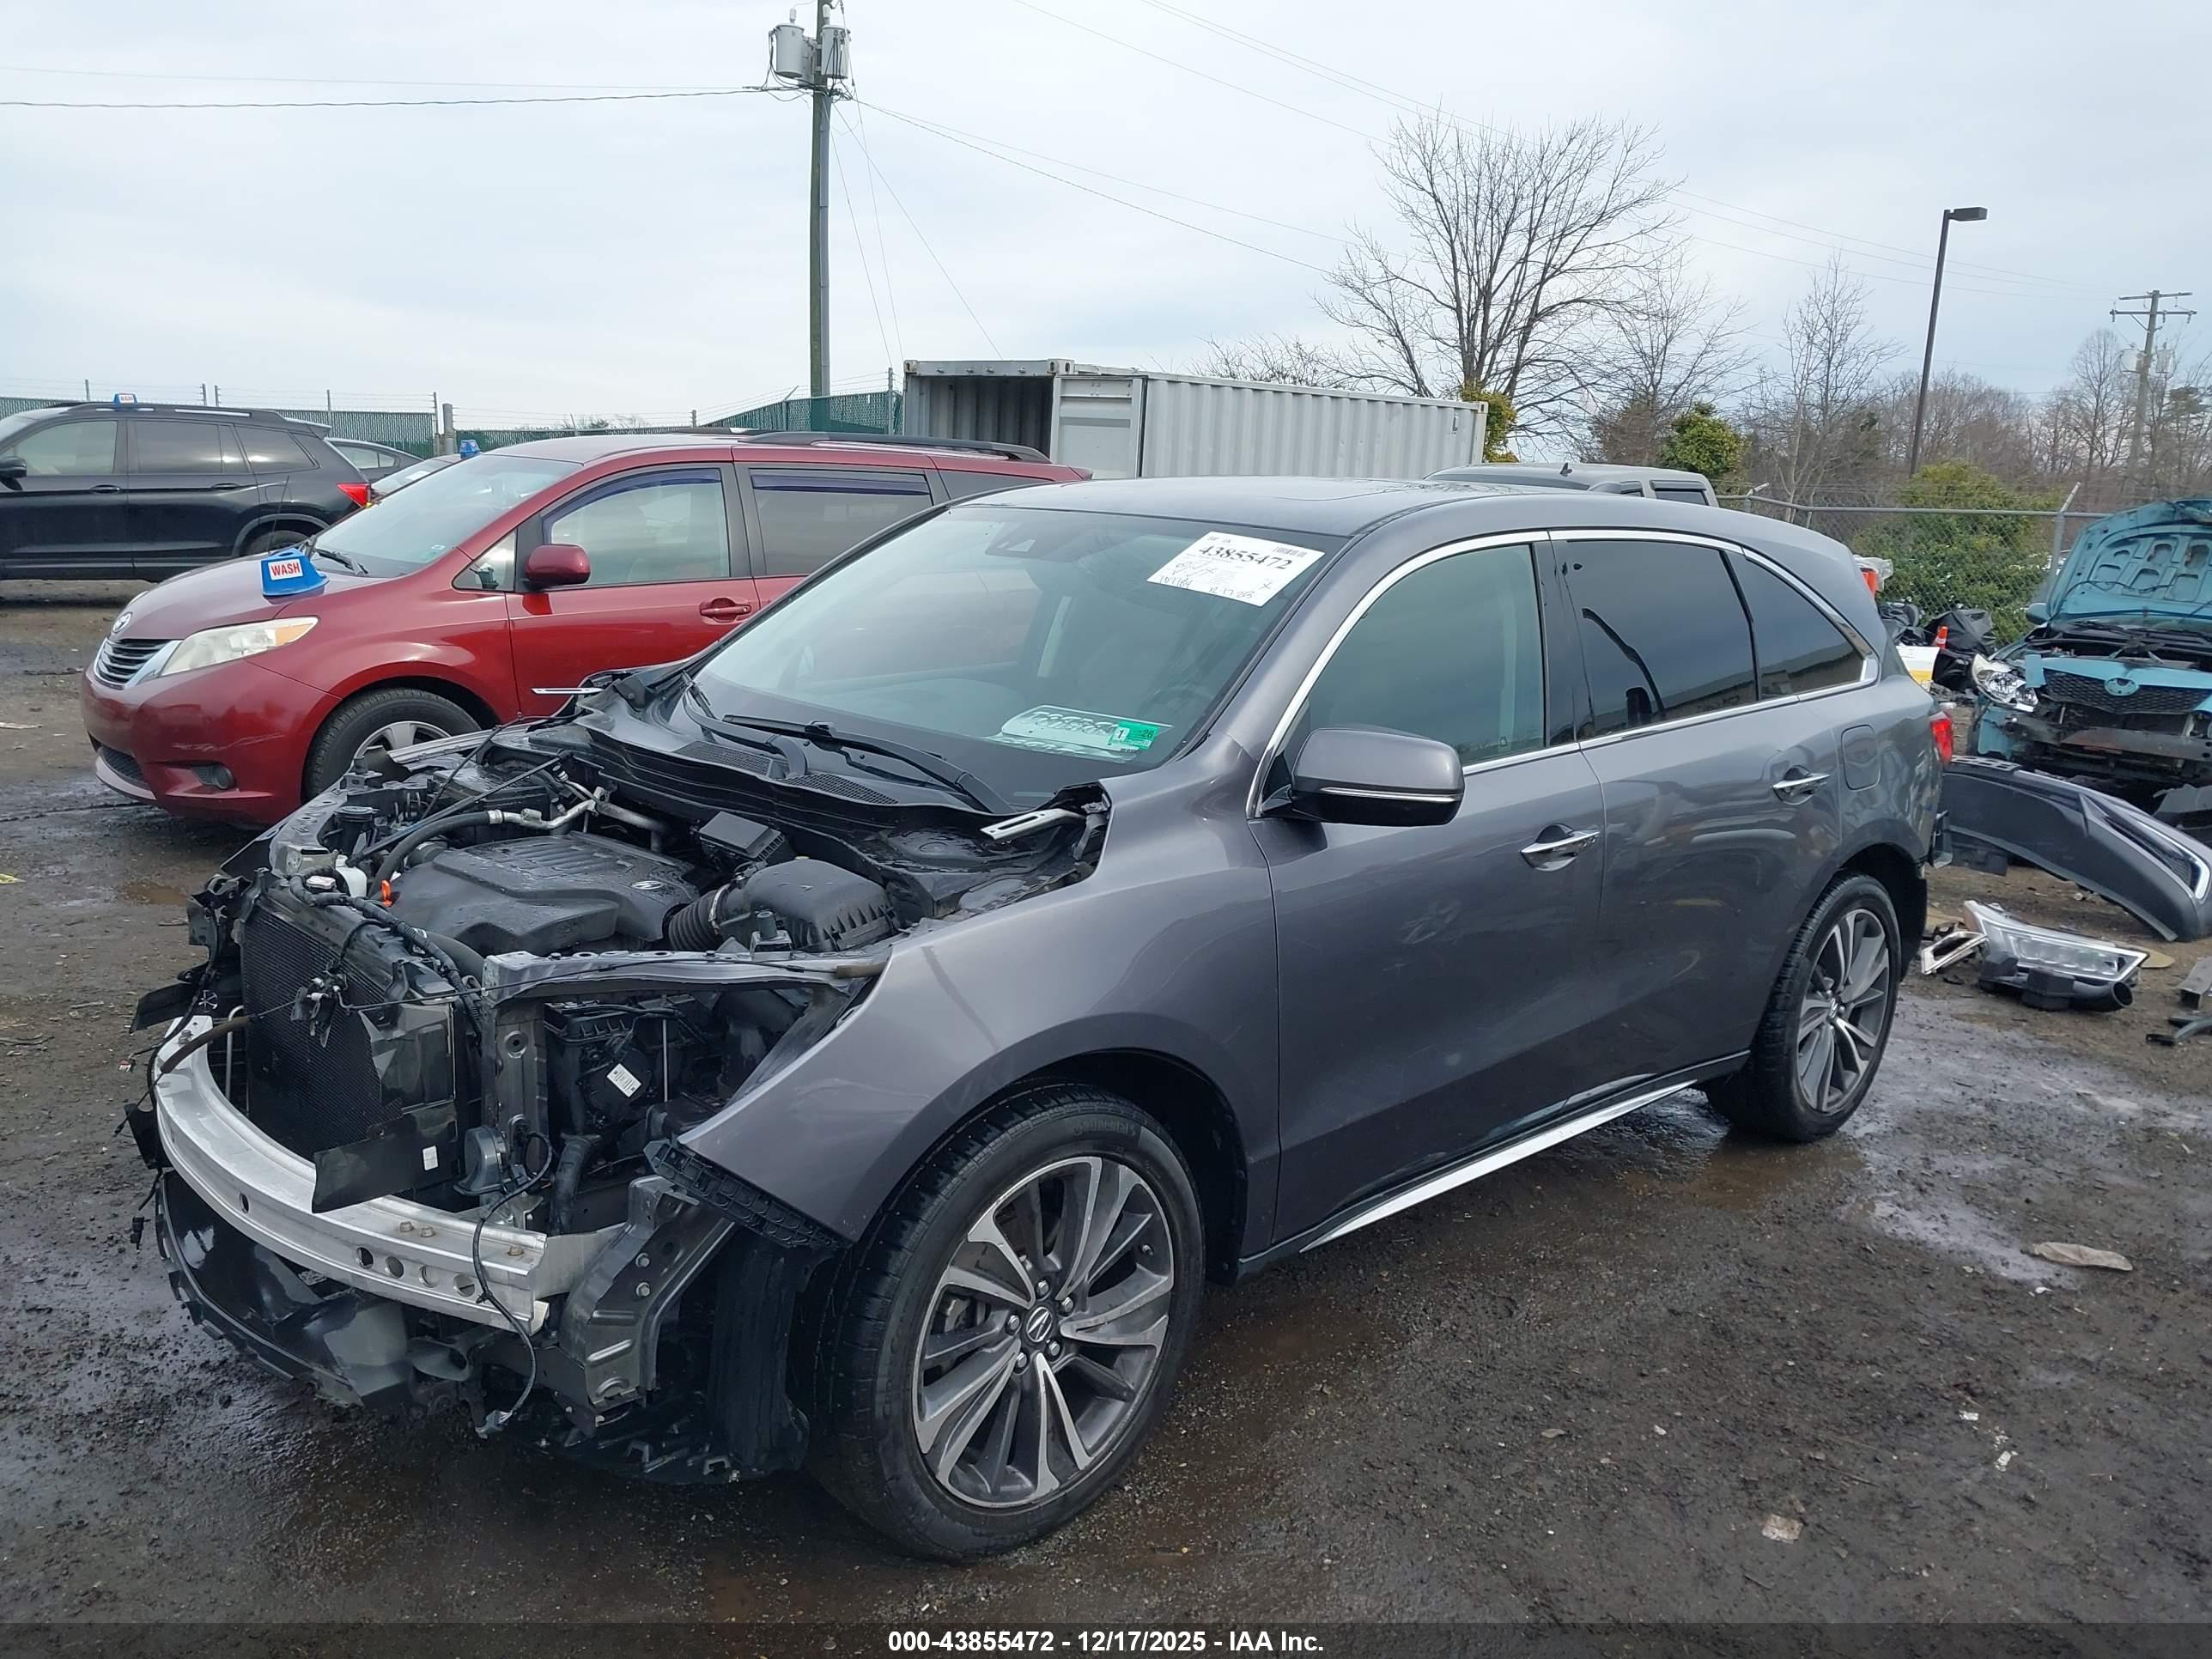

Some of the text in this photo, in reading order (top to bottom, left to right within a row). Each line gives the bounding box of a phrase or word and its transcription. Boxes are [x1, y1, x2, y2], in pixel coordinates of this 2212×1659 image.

[1199, 545, 1293, 570] 43855472
[270, 562, 301, 576] WASH
[1141, 729, 1155, 738] 26
